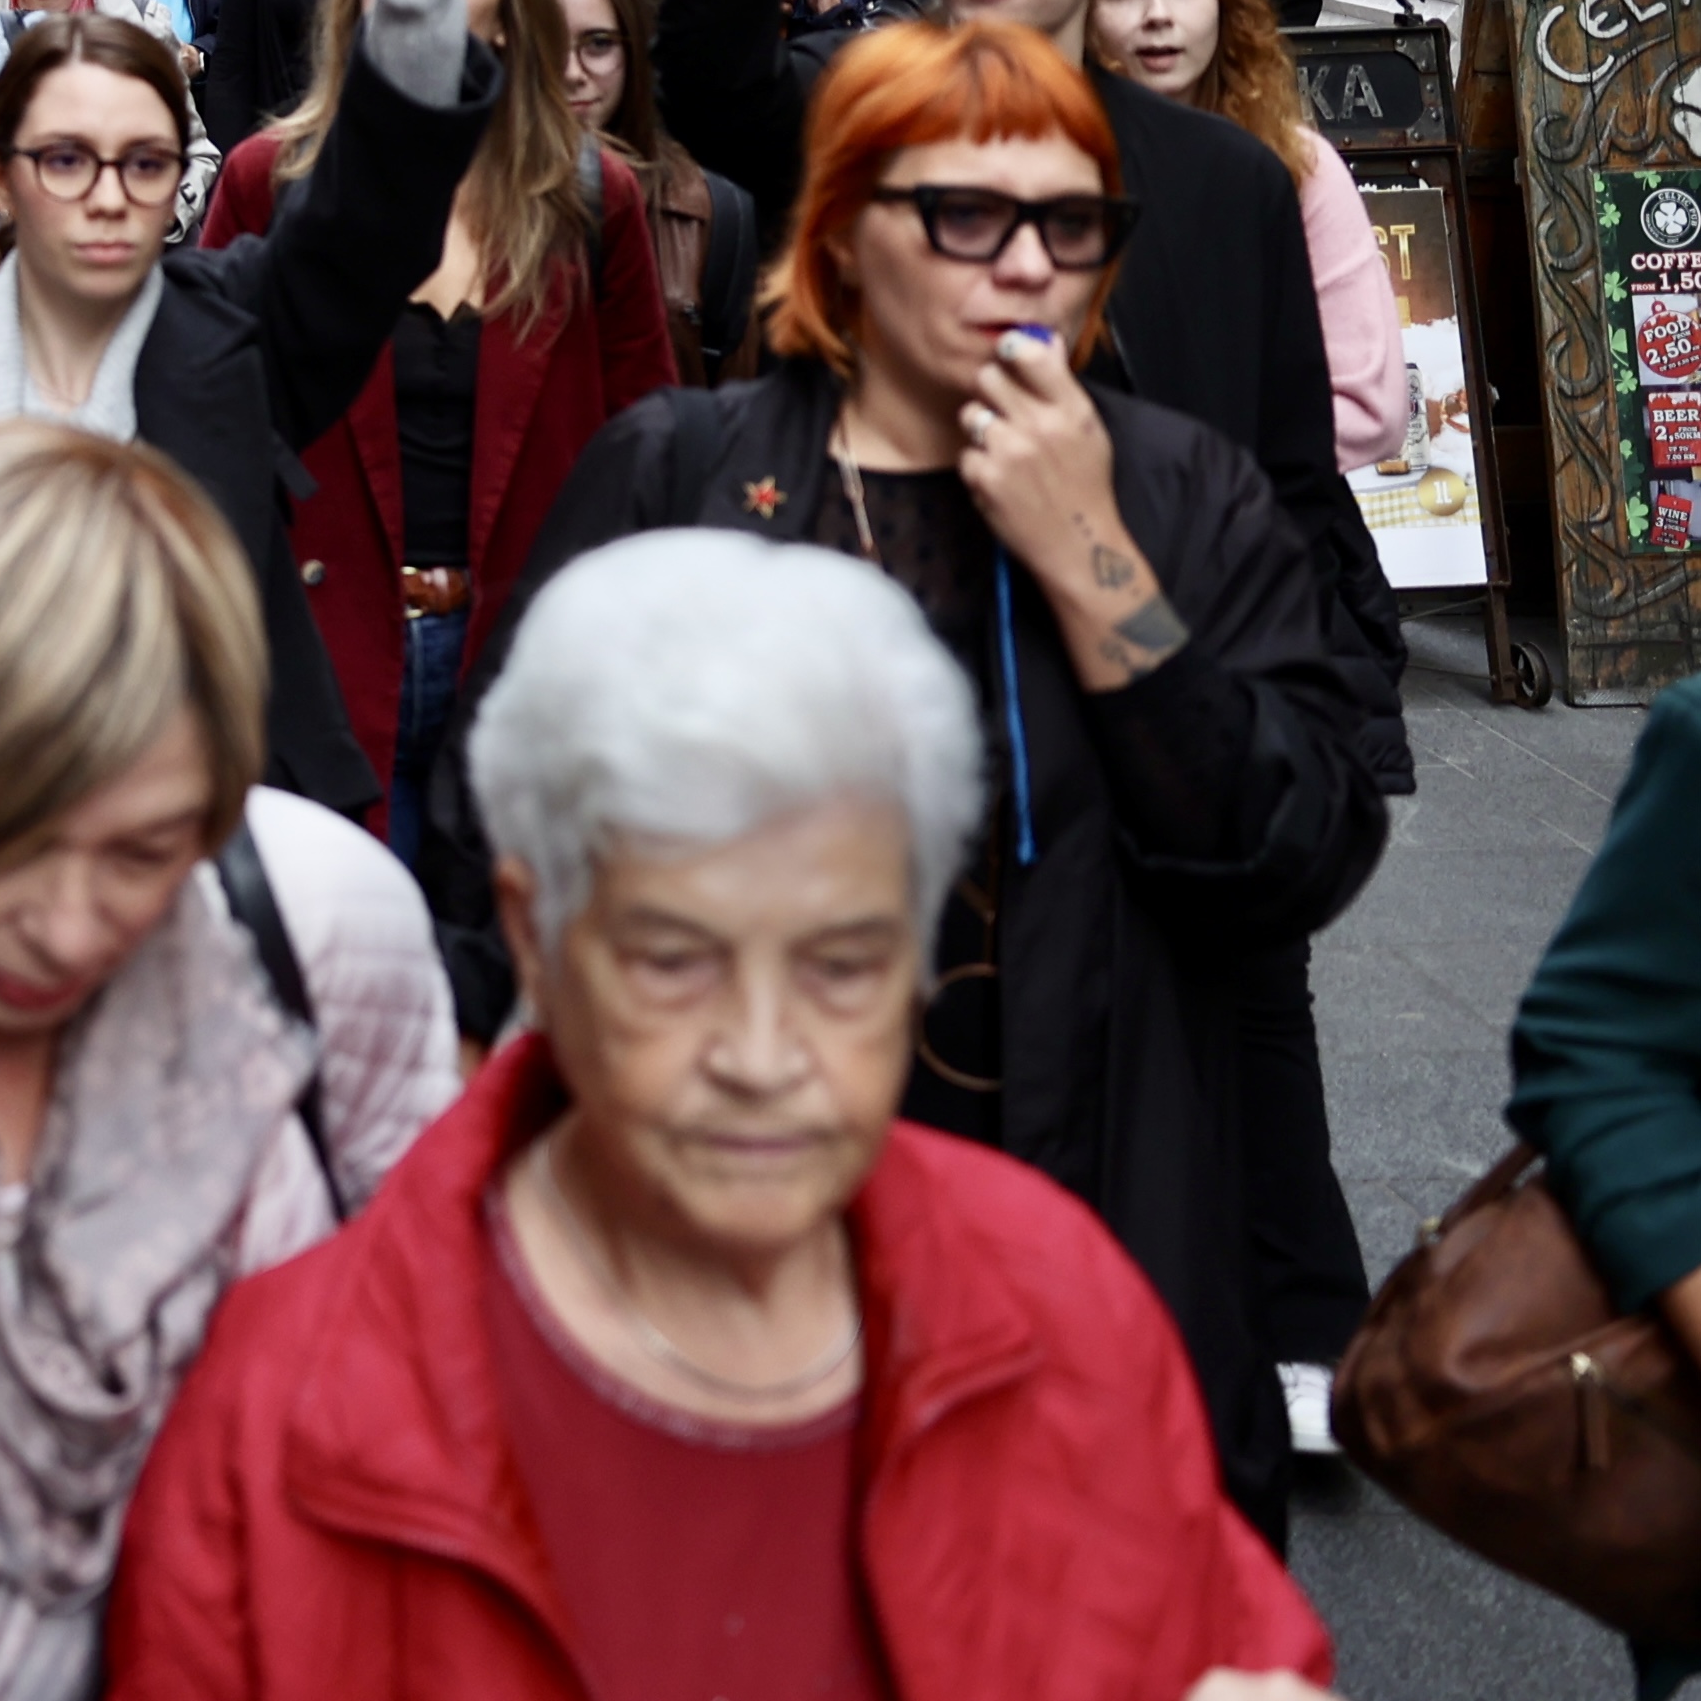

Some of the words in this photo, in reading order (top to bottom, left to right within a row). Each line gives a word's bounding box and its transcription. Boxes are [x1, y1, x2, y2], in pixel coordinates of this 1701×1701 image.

[1631, 283, 1656, 291] FROM
[1643, 318, 1692, 343] FOOD
[1646, 338, 1692, 365] 2,50
[1652, 409, 1701, 423] BEER
[1658, 506, 1689, 521] WINE
